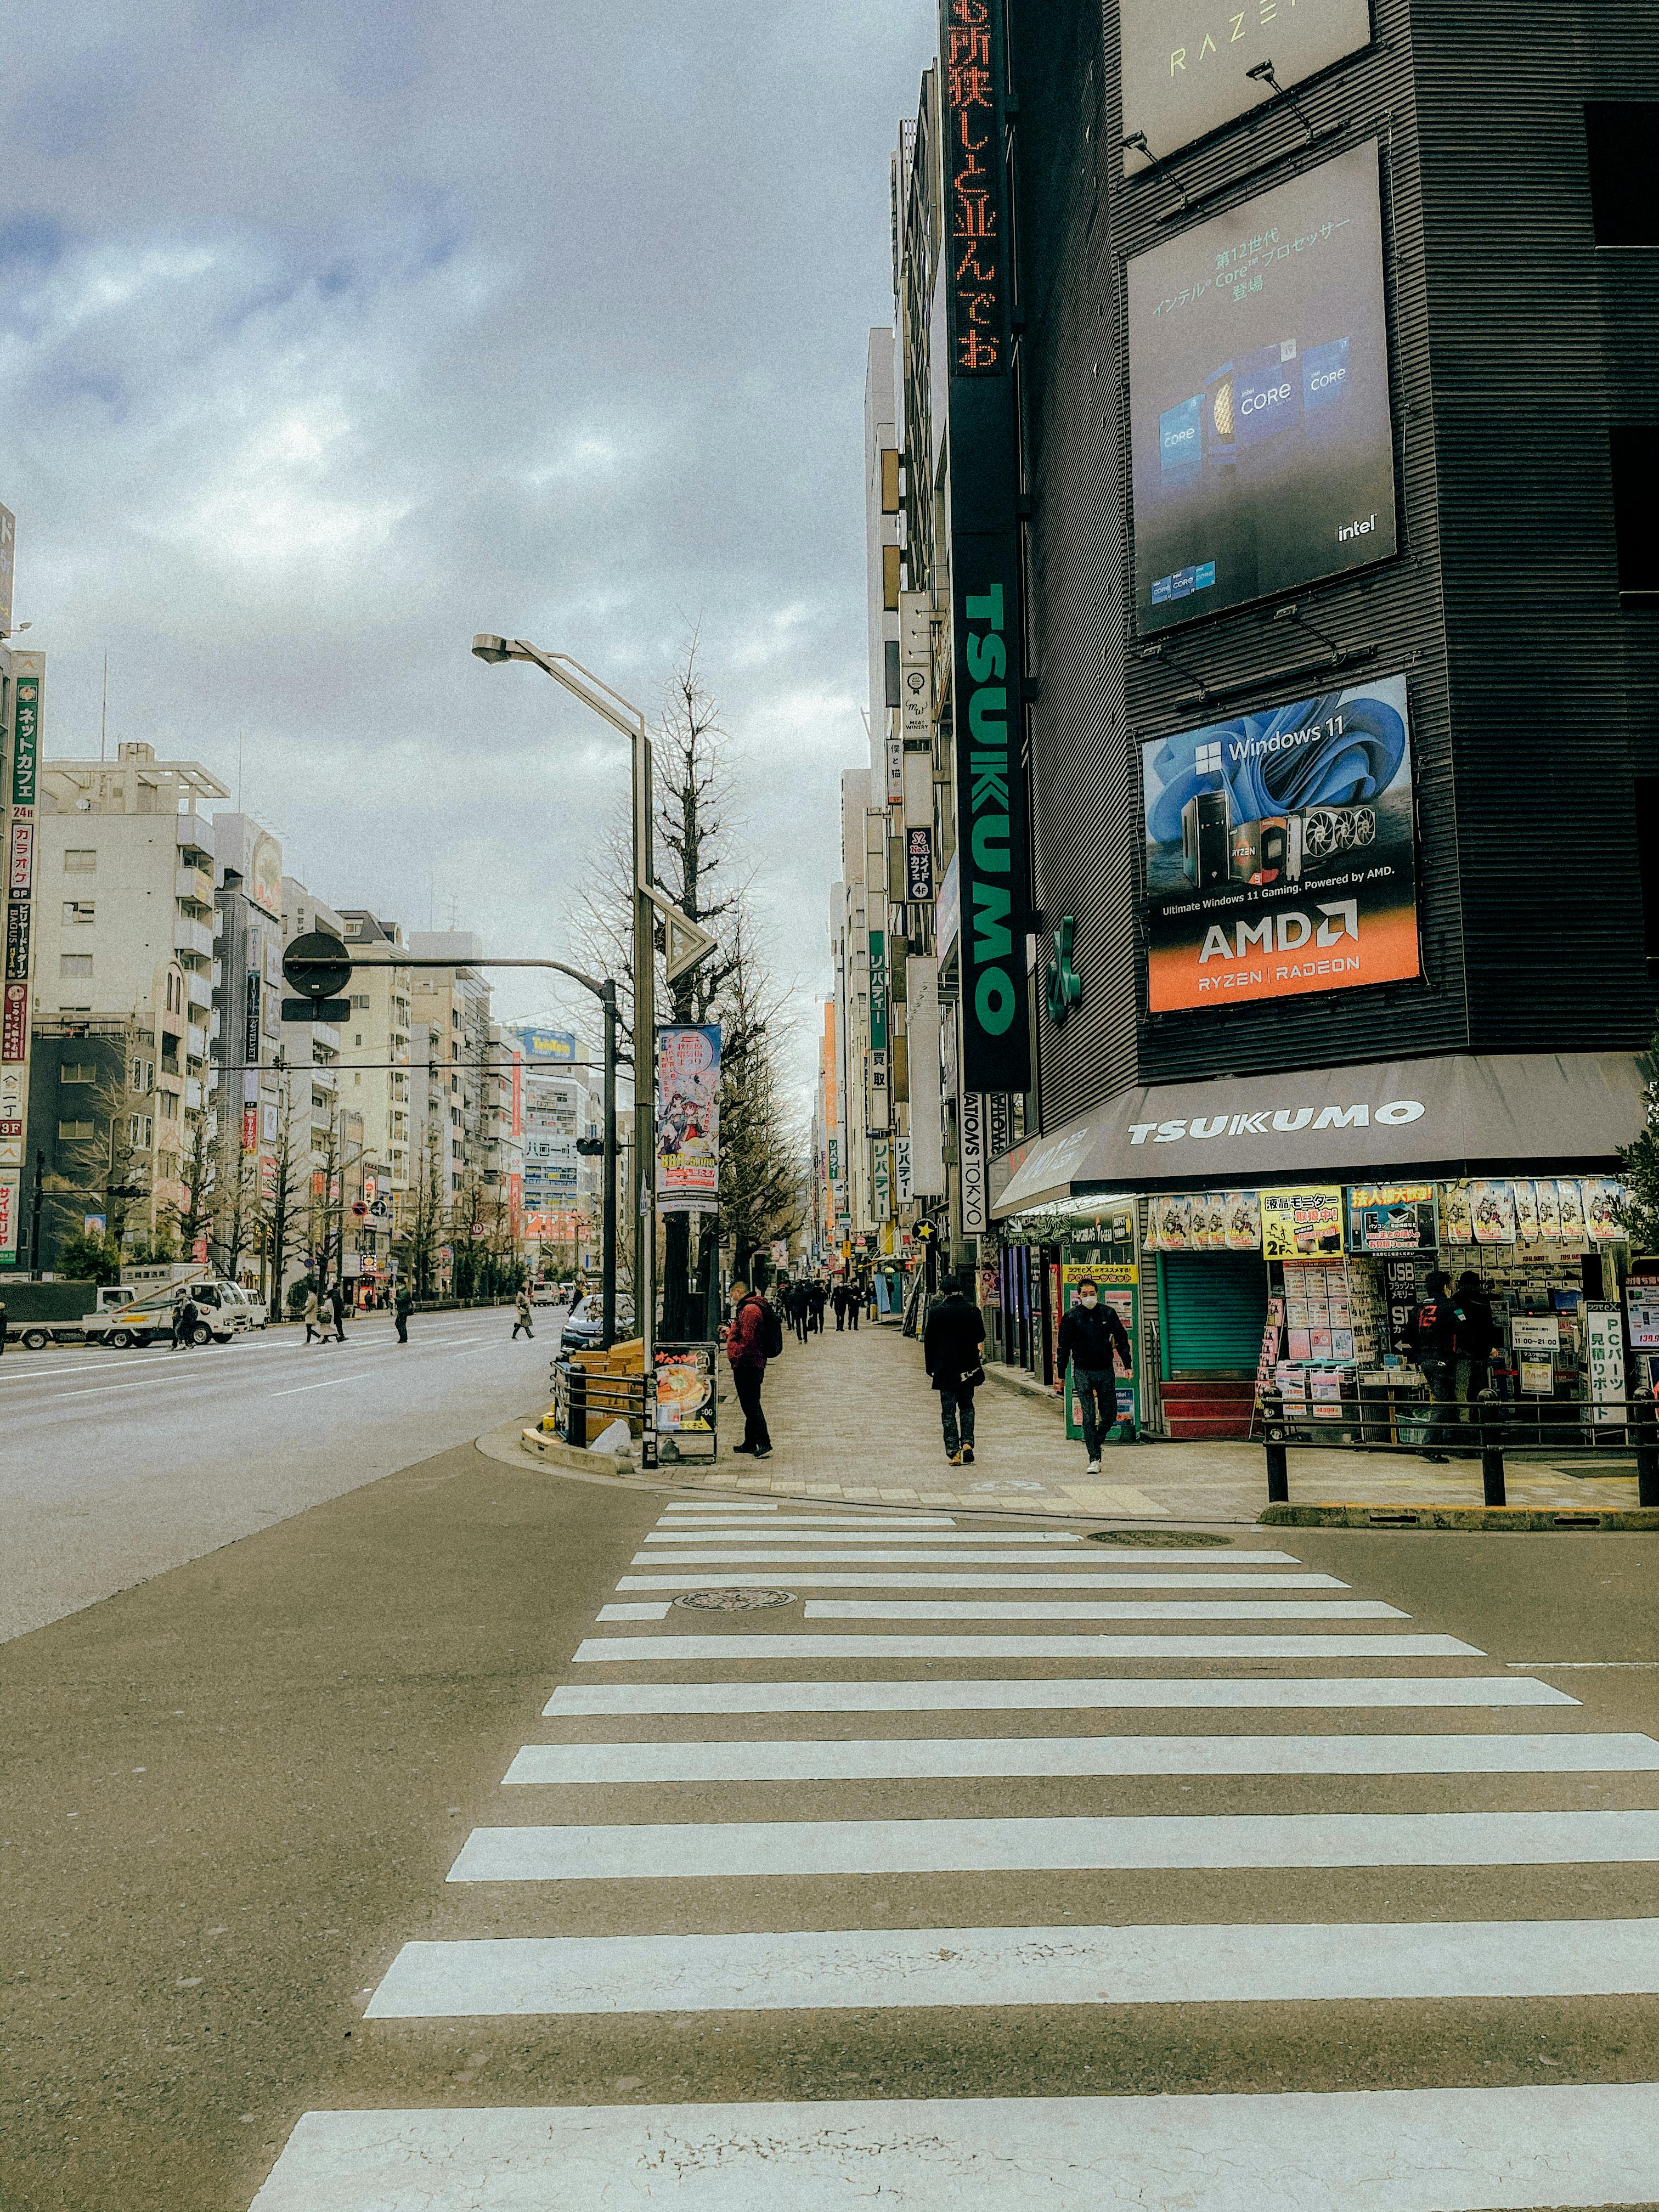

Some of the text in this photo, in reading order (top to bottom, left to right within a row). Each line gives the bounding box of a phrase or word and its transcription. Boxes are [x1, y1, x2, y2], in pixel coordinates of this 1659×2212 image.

[1170, 0, 1296, 77] RAZE
[1215, 227, 1279, 270] 第12世代
[1262, 219, 1350, 268] プロセッサー
[1233, 274, 1263, 302] 登場
[16, 708, 36, 798] ネットカフェ
[1229, 715, 1344, 761] Windows 11
[14, 807, 33, 819] 24H
[966, 583, 1015, 1036] TSUKUMO
[14, 829, 30, 884] カラオケ
[1232, 847, 1256, 857] RYZEN
[915, 885, 926, 895] 4F
[1163, 866, 1395, 917] Ultimate Windows 11 Gaming. Powered by AMD.
[1198, 911, 1313, 964] AMD
[871, 955, 885, 1024] リバティー
[1198, 956, 1360, 992] RYZEN RADEON
[873, 1053, 885, 1086] 買取
[1127, 1099, 1426, 1145] TSUKUMO
[873, 1145, 888, 1216] リバティー
[898, 1142, 910, 1197] リバティー
[965, 1160, 982, 1225] TOKYO
[1387, 1262, 1414, 1281] USB
[1389, 1282, 1415, 1290] フラッシュ
[1591, 1334, 1607, 1420] 見積りボード
[1607, 1319, 1623, 1390] PCパーツ
